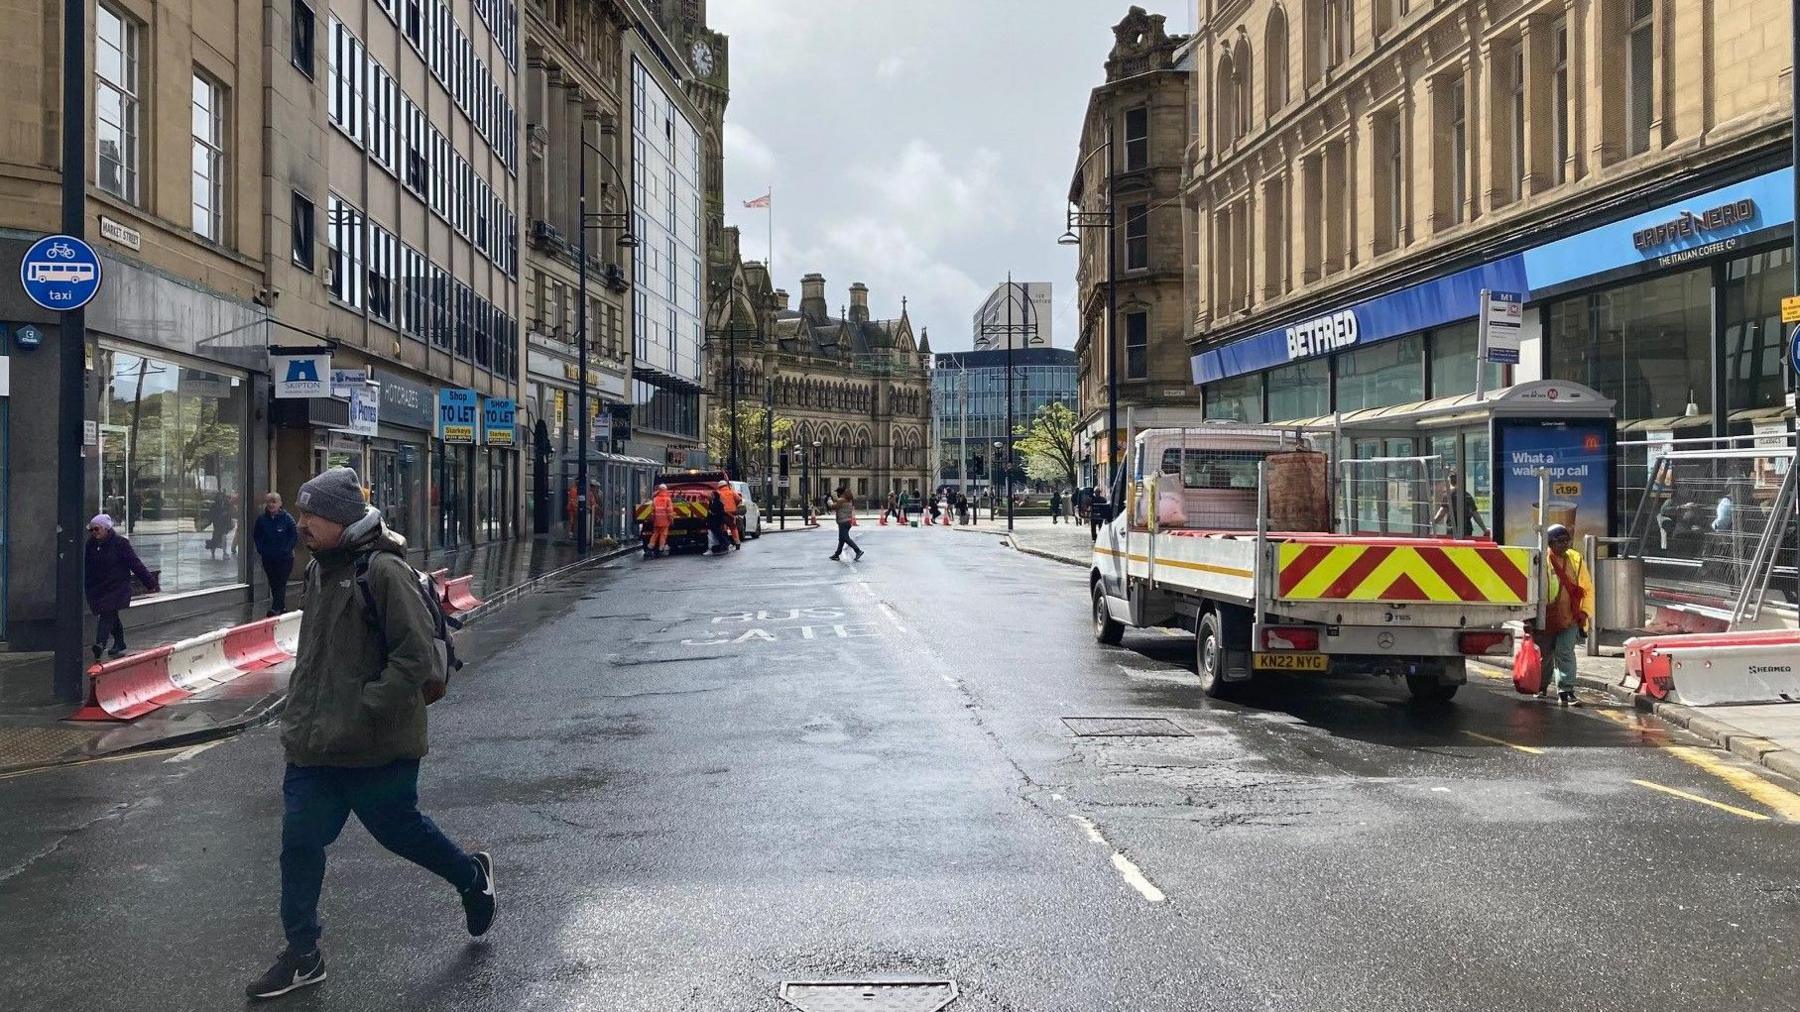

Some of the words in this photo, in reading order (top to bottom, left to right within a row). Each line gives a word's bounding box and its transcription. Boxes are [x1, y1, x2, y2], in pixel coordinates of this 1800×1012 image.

[102, 220, 122, 238] MARKET
[123, 230, 139, 246] STREET
[1658, 257, 1671, 267] THE
[1672, 249, 1698, 264] ITALIAN
[1699, 241, 1725, 256] COFFEE
[49, 290, 72, 300] taxi
[1500, 293, 1513, 301] M1
[1286, 310, 1358, 359] BETFRED
[284, 382, 321, 390] SKIPTON
[449, 391, 468, 402] Shop
[490, 400, 509, 409] SHOP
[441, 405, 455, 422] TO
[457, 405, 475, 423] LET
[485, 410, 497, 423] TO
[499, 410, 515, 424] LET
[1512, 451, 1544, 464] What
[1546, 453, 1554, 464] a
[1567, 465, 1588, 476] call
[711, 607, 845, 623] BUS
[1260, 656, 1293, 668] KN22
[1296, 656, 1321, 668] NYG
